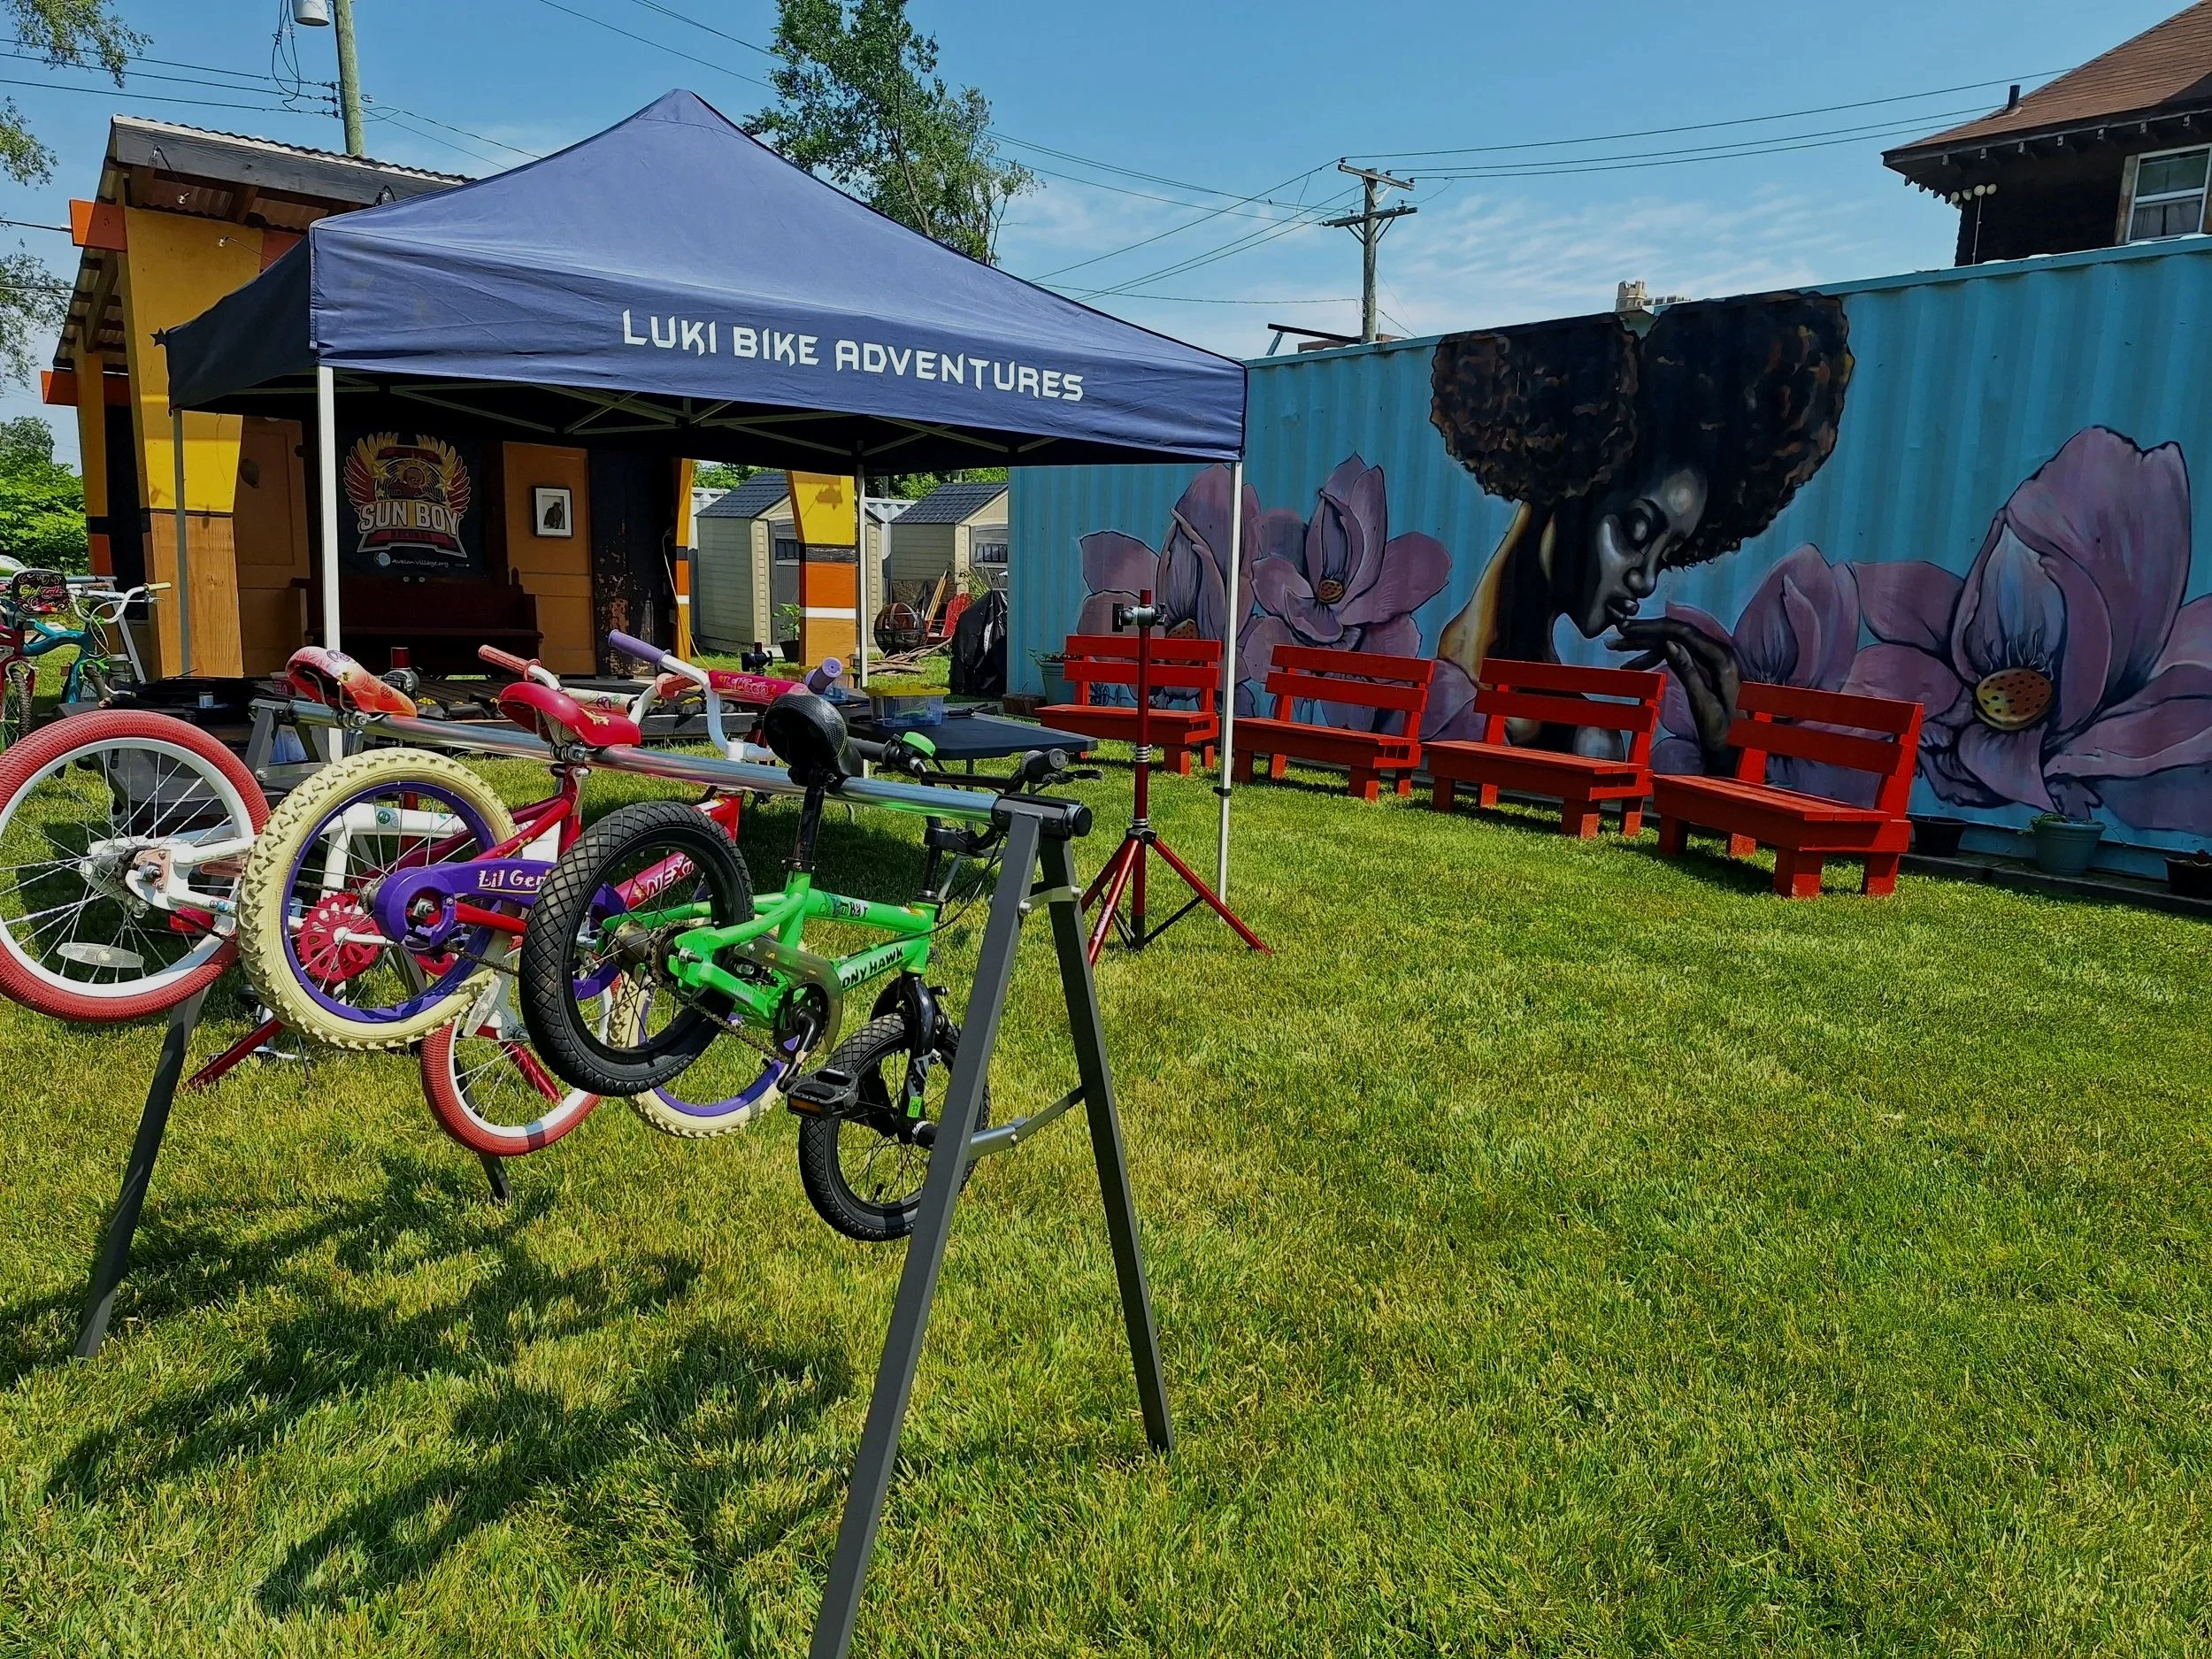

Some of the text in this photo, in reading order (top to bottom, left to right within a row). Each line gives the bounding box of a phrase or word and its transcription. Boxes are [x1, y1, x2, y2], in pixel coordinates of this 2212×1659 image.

[622, 308, 1084, 402] LUKI BIKE ADVENTURES
[360, 501, 459, 535] SUN BOY
[841, 947, 903, 989] ONY HAWK
